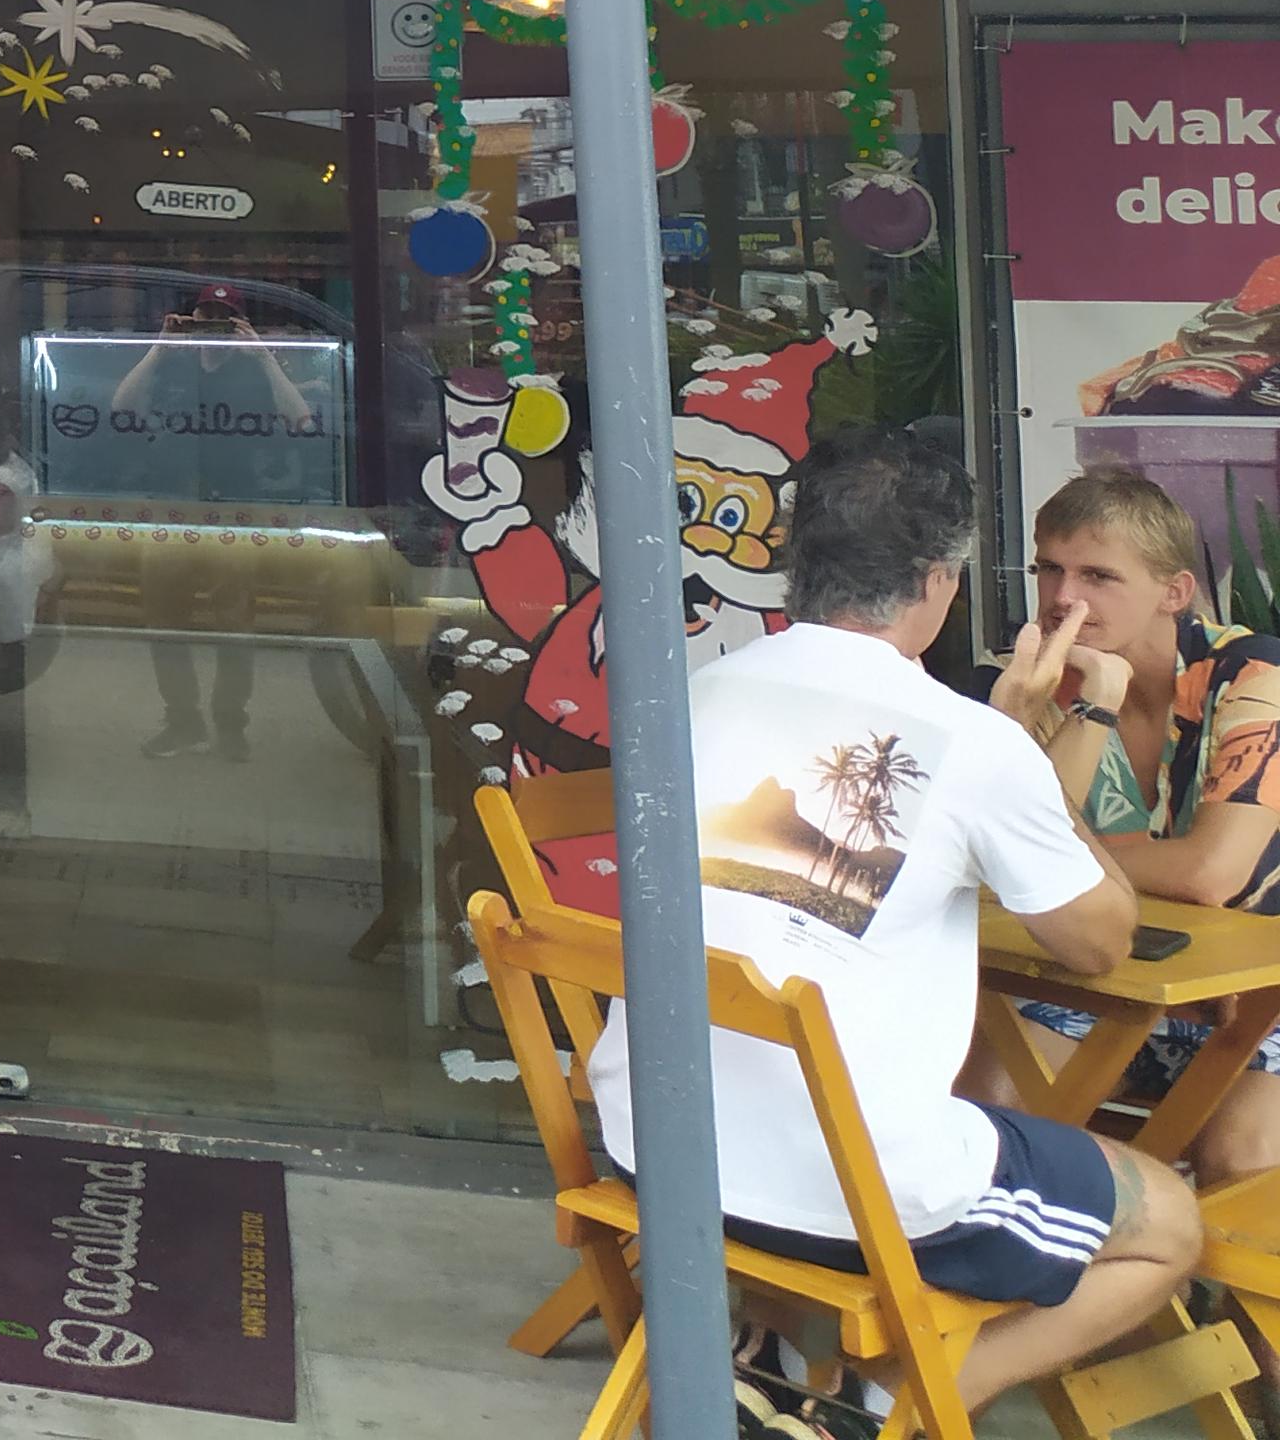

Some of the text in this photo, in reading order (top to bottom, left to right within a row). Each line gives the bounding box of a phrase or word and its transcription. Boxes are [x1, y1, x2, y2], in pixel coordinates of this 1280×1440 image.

[1112, 97, 1280, 145] Mak
[152, 189, 236, 212] ABERTO
[109, 401, 326, 443] açailand
[51, 1157, 160, 1317] açailand
